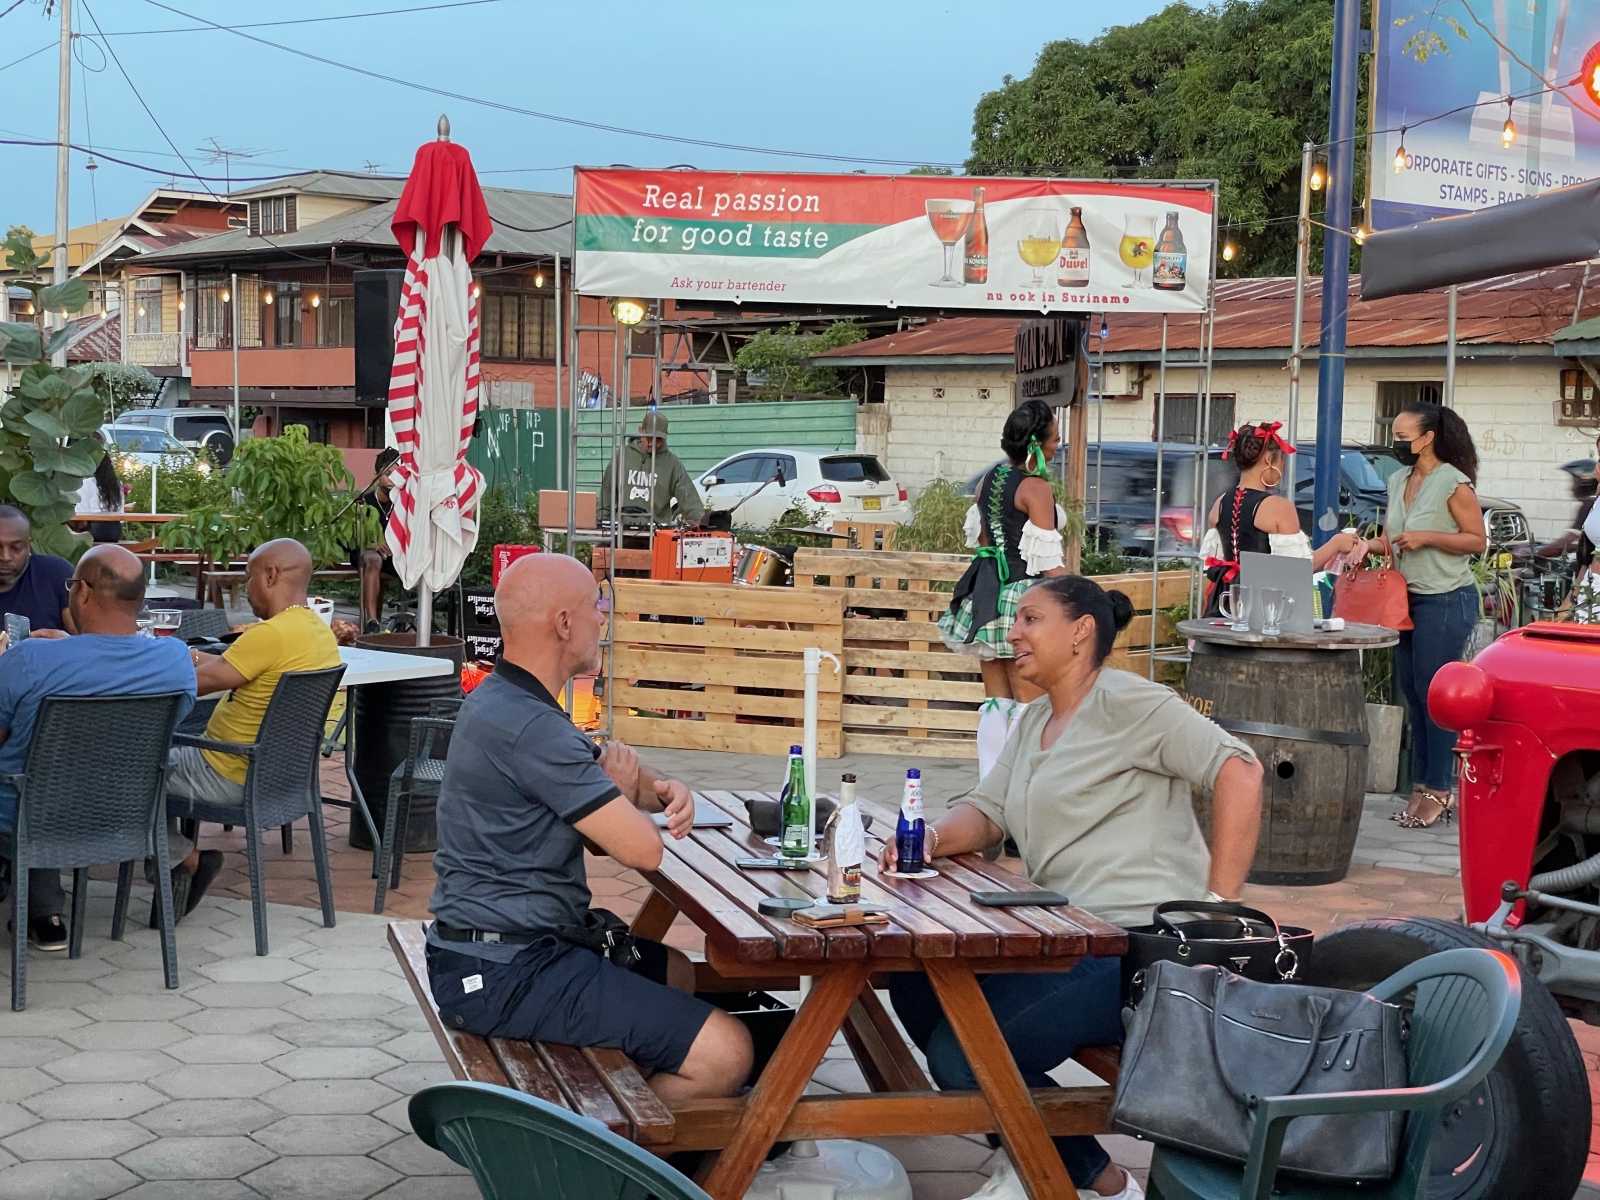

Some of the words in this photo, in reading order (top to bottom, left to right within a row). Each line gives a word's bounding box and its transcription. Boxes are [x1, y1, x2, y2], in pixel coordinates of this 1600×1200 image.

[1402, 154, 1473, 177] ORPORATE
[1476, 162, 1508, 182] GIFTS
[1518, 168, 1552, 188] SIGNS
[643, 184, 703, 210] Real
[712, 187, 820, 216] passion
[1439, 184, 1488, 205] STAMPS
[632, 218, 672, 243] for
[681, 223, 753, 250] good
[763, 224, 829, 249] taste
[1060, 255, 1088, 269] Duvel
[670, 276, 694, 289] Ask
[696, 279, 724, 291] your
[727, 279, 787, 292] bartender
[986, 292, 1003, 301] nu
[1009, 291, 1036, 302] ook
[1041, 291, 1056, 303] in
[1061, 292, 1130, 304] Suriname
[627, 469, 658, 487] KING
